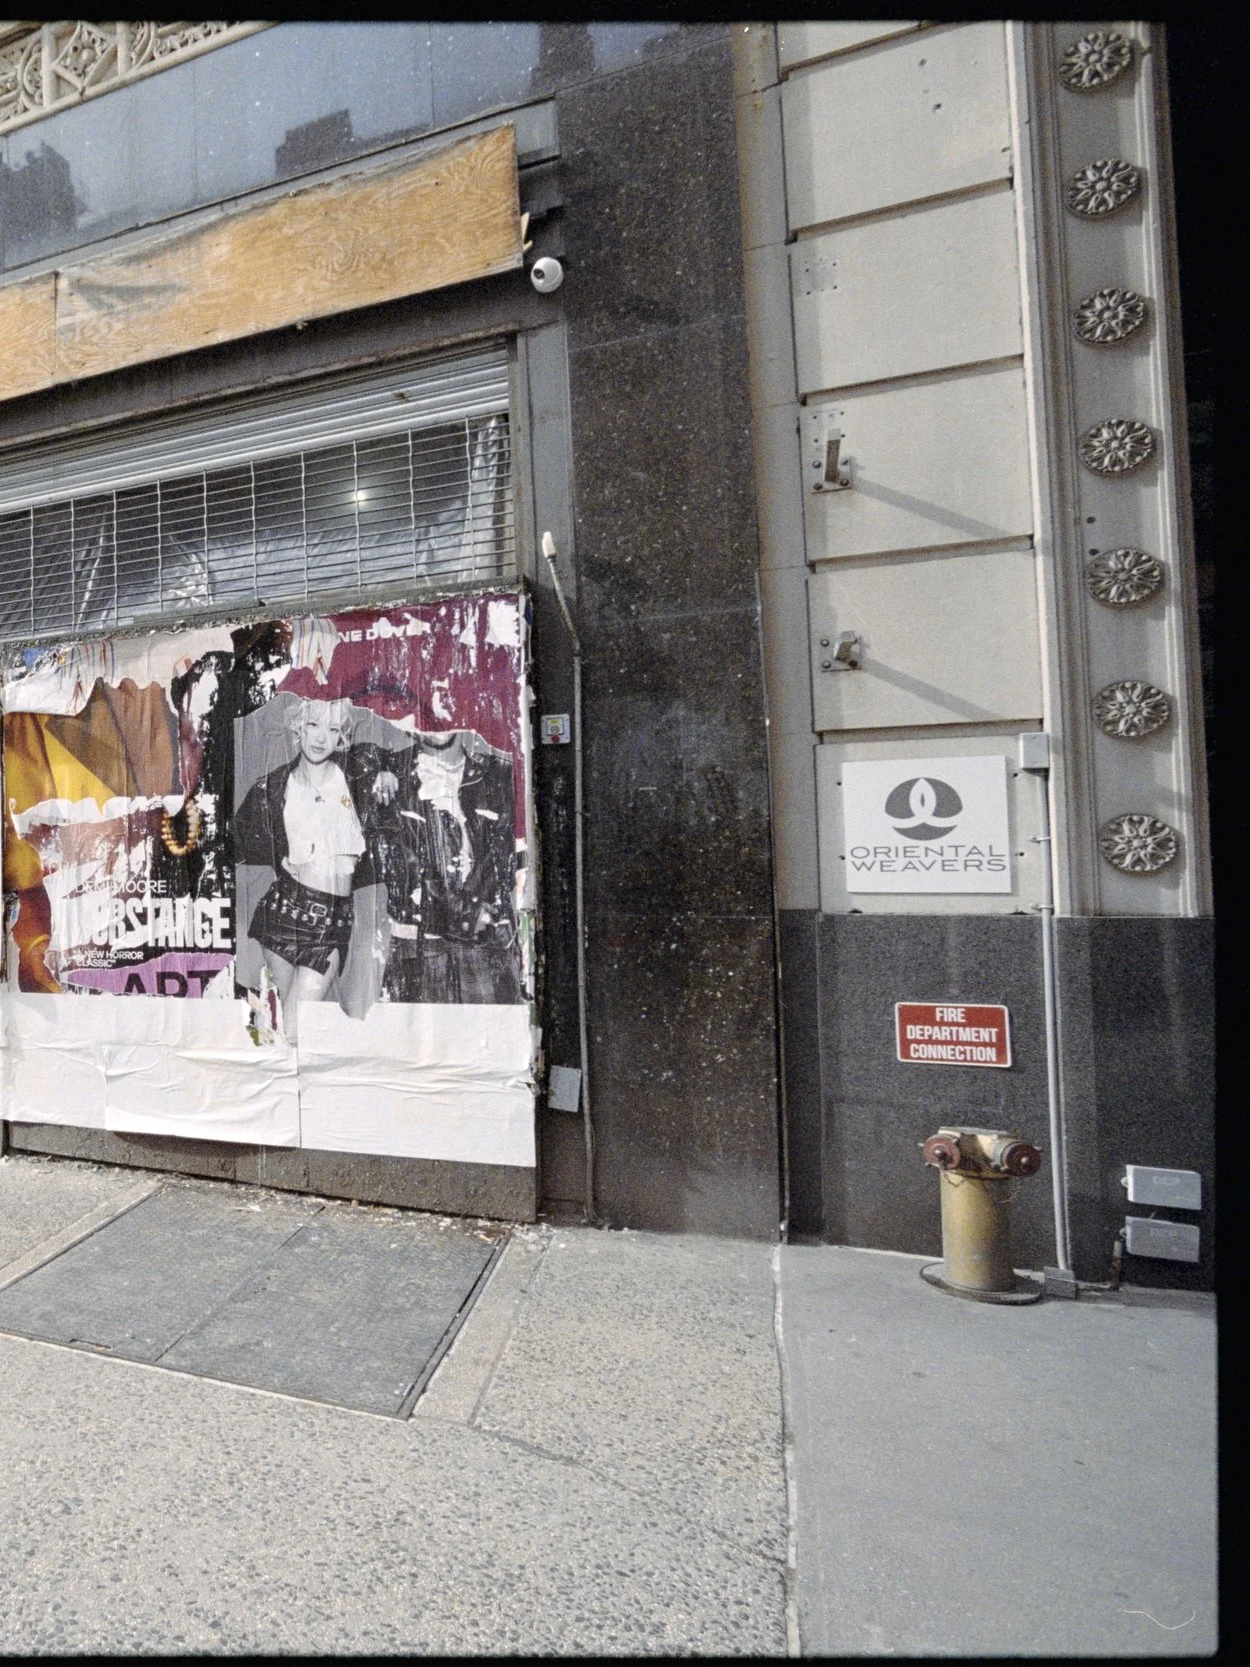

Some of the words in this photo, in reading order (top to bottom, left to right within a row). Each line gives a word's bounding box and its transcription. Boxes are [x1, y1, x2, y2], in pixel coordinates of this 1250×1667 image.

[366, 621, 431, 640] DOV
[850, 844, 1007, 859] ORIENTAL
[850, 858, 1007, 873] WEAVERS
[113, 880, 167, 893] MOORE
[91, 897, 233, 949] UBSTANCE
[85, 950, 105, 959] NEW
[106, 950, 144, 960] HORROR
[935, 1007, 966, 1022] FIRE
[906, 1025, 998, 1043] DEPARTMENT
[910, 1043, 997, 1062] CONNECTION
